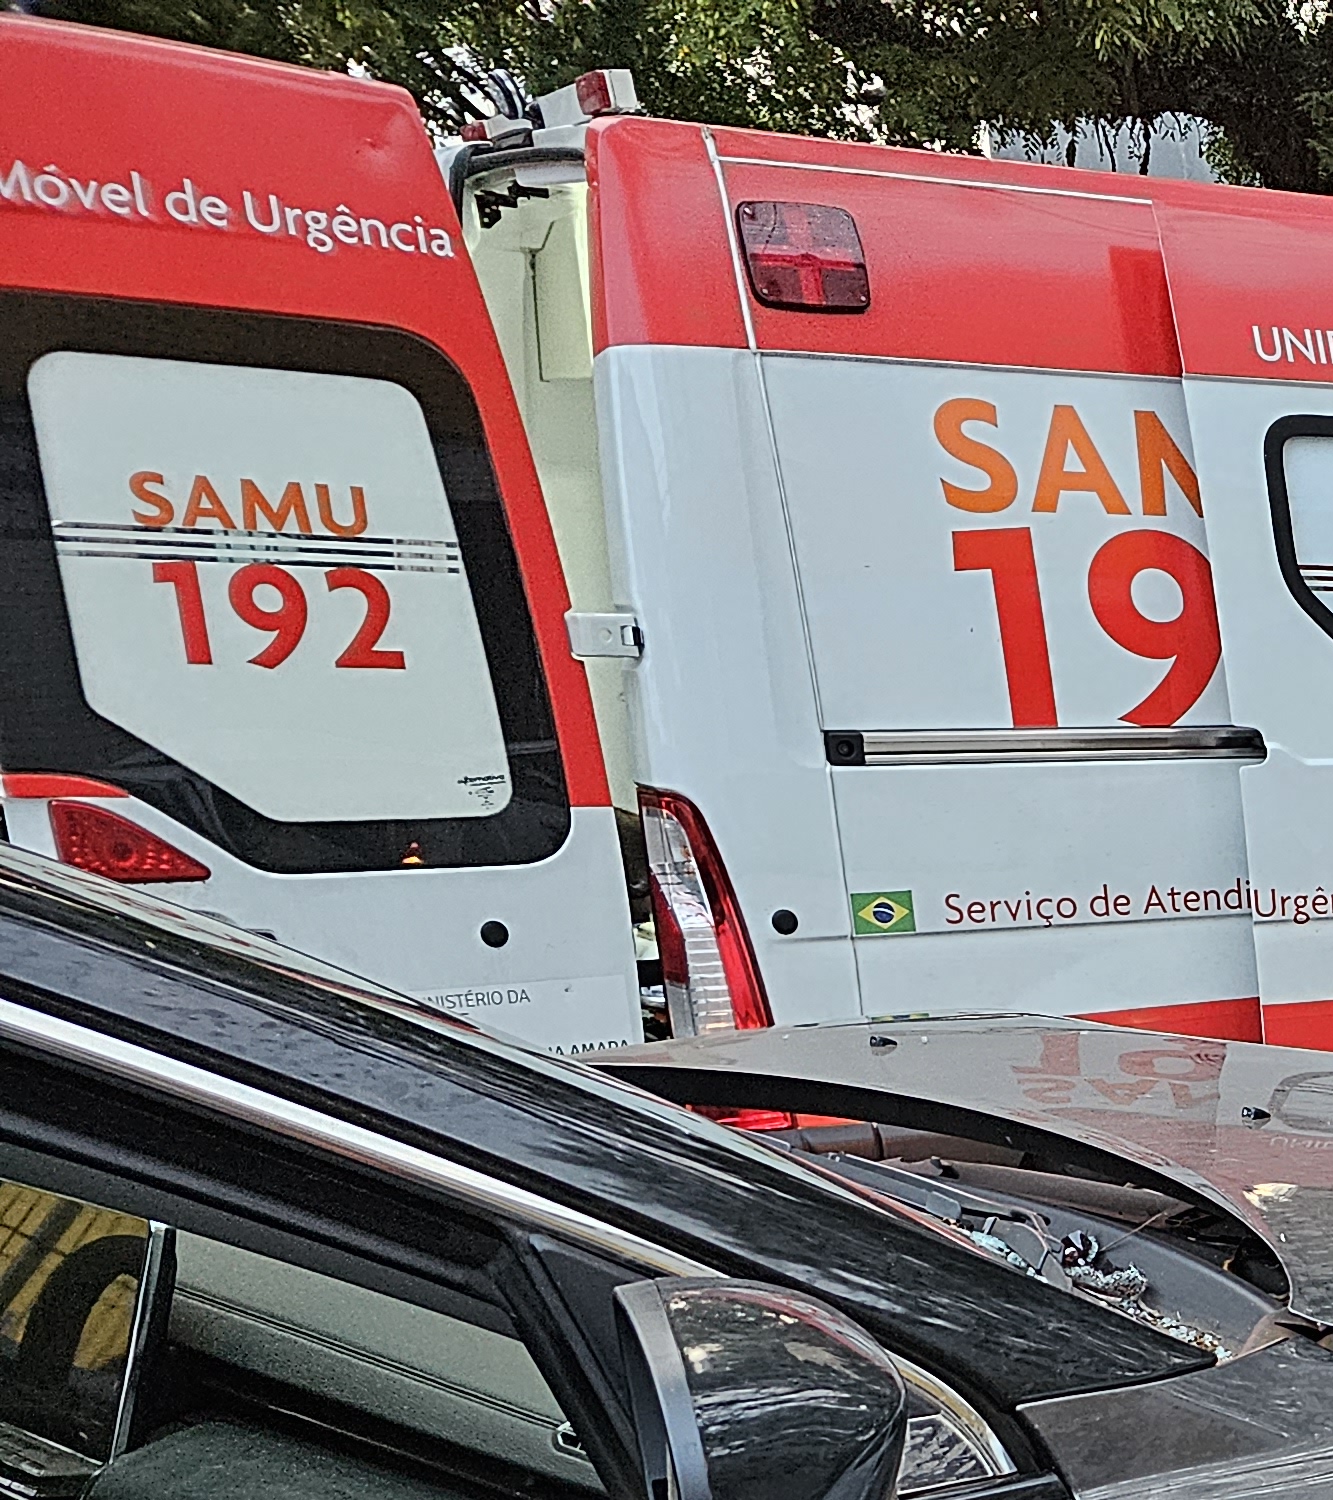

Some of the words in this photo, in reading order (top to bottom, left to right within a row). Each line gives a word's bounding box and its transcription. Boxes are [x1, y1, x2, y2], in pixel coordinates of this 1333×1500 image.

[165, 177, 229, 227] de
[243, 190, 456, 254] Urgência
[128, 470, 368, 538] SAMU
[152, 560, 407, 669] 192
[945, 890, 1078, 928] Serviço
[1089, 884, 1131, 917] de
[1143, 877, 1251, 915] Atendi
[507, 988, 531, 1005] DA
